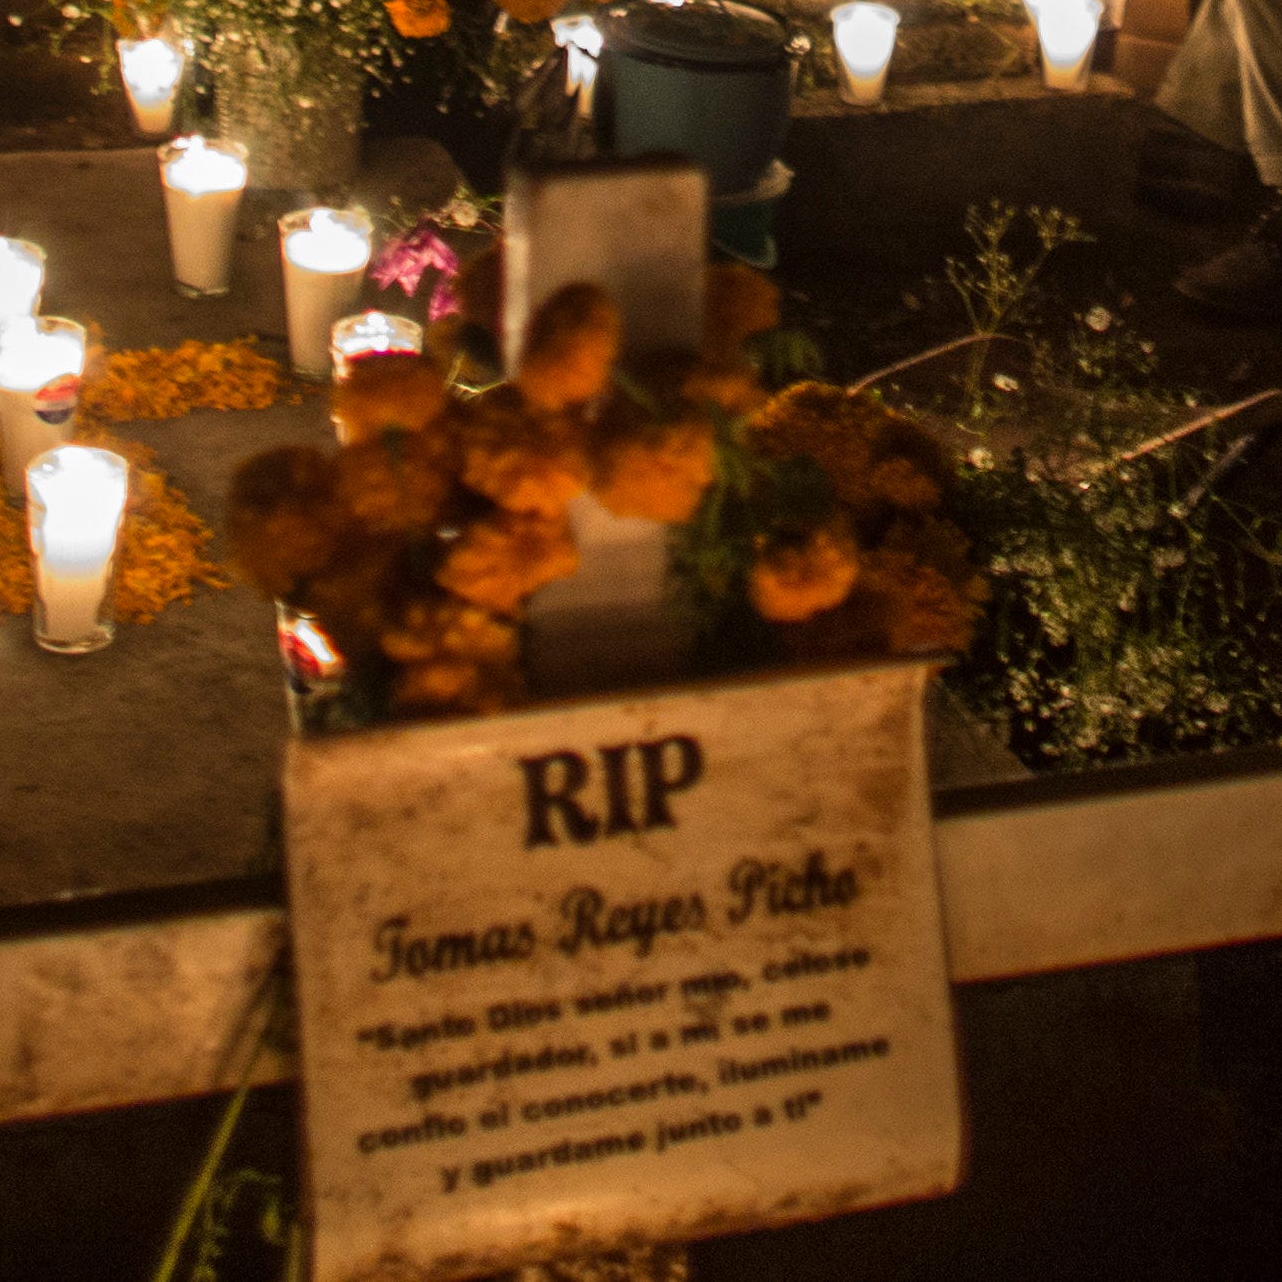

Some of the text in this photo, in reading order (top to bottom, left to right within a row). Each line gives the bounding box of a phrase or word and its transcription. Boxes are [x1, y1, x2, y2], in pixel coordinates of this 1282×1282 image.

[516, 735, 706, 851] RIP
[369, 849, 861, 983] Tomas Reyes Picho
[410, 1045, 600, 1102] guardador,
[649, 1029, 670, 1052] a
[731, 1013, 769, 1036] se
[780, 1000, 831, 1028] me
[487, 999, 563, 1033] Dios
[519, 1073, 711, 1123] conocerte,
[440, 1167, 461, 1195] y
[473, 1130, 647, 1187] guardame
[656, 1112, 743, 1154] junto
[752, 1104, 773, 1128] a
